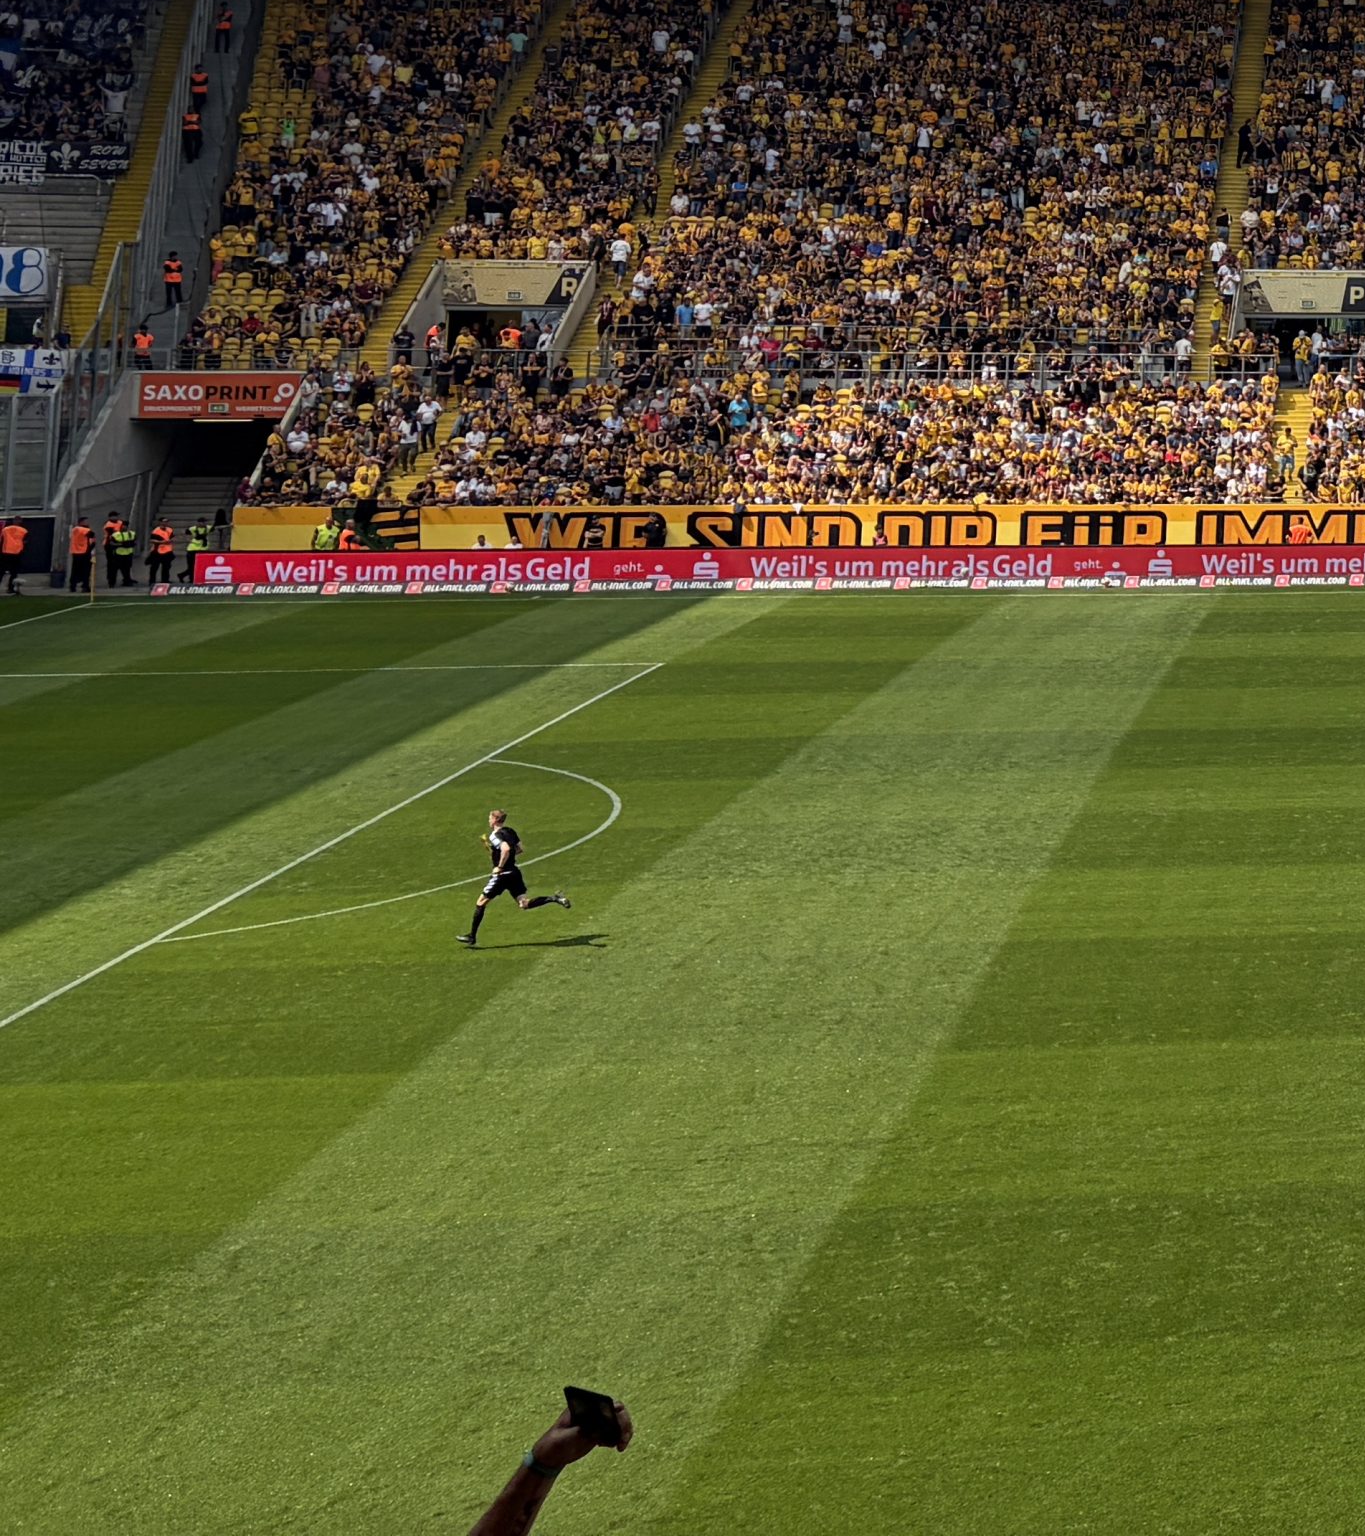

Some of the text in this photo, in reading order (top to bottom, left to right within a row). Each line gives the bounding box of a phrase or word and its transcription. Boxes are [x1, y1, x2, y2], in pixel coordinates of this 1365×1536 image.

[90, 145, 127, 156] ROW
[79, 159, 129, 170] SEVEN
[561, 277, 578, 297] R
[1350, 286, 1365, 305] P
[143, 384, 271, 401] SAXOPRINT
[688, 512, 862, 547] SIND
[266, 560, 350, 582] Weil's
[354, 566, 397, 582] um
[406, 559, 477, 582] mehr
[481, 558, 522, 582] als
[526, 557, 591, 582] Geld
[749, 556, 828, 578] Weil's
[835, 561, 877, 578] um
[884, 555, 950, 578] mehr
[951, 555, 992, 578] als
[991, 554, 1055, 578] Geld
[1202, 553, 1274, 575] Weil's
[1279, 559, 1318, 575] um
